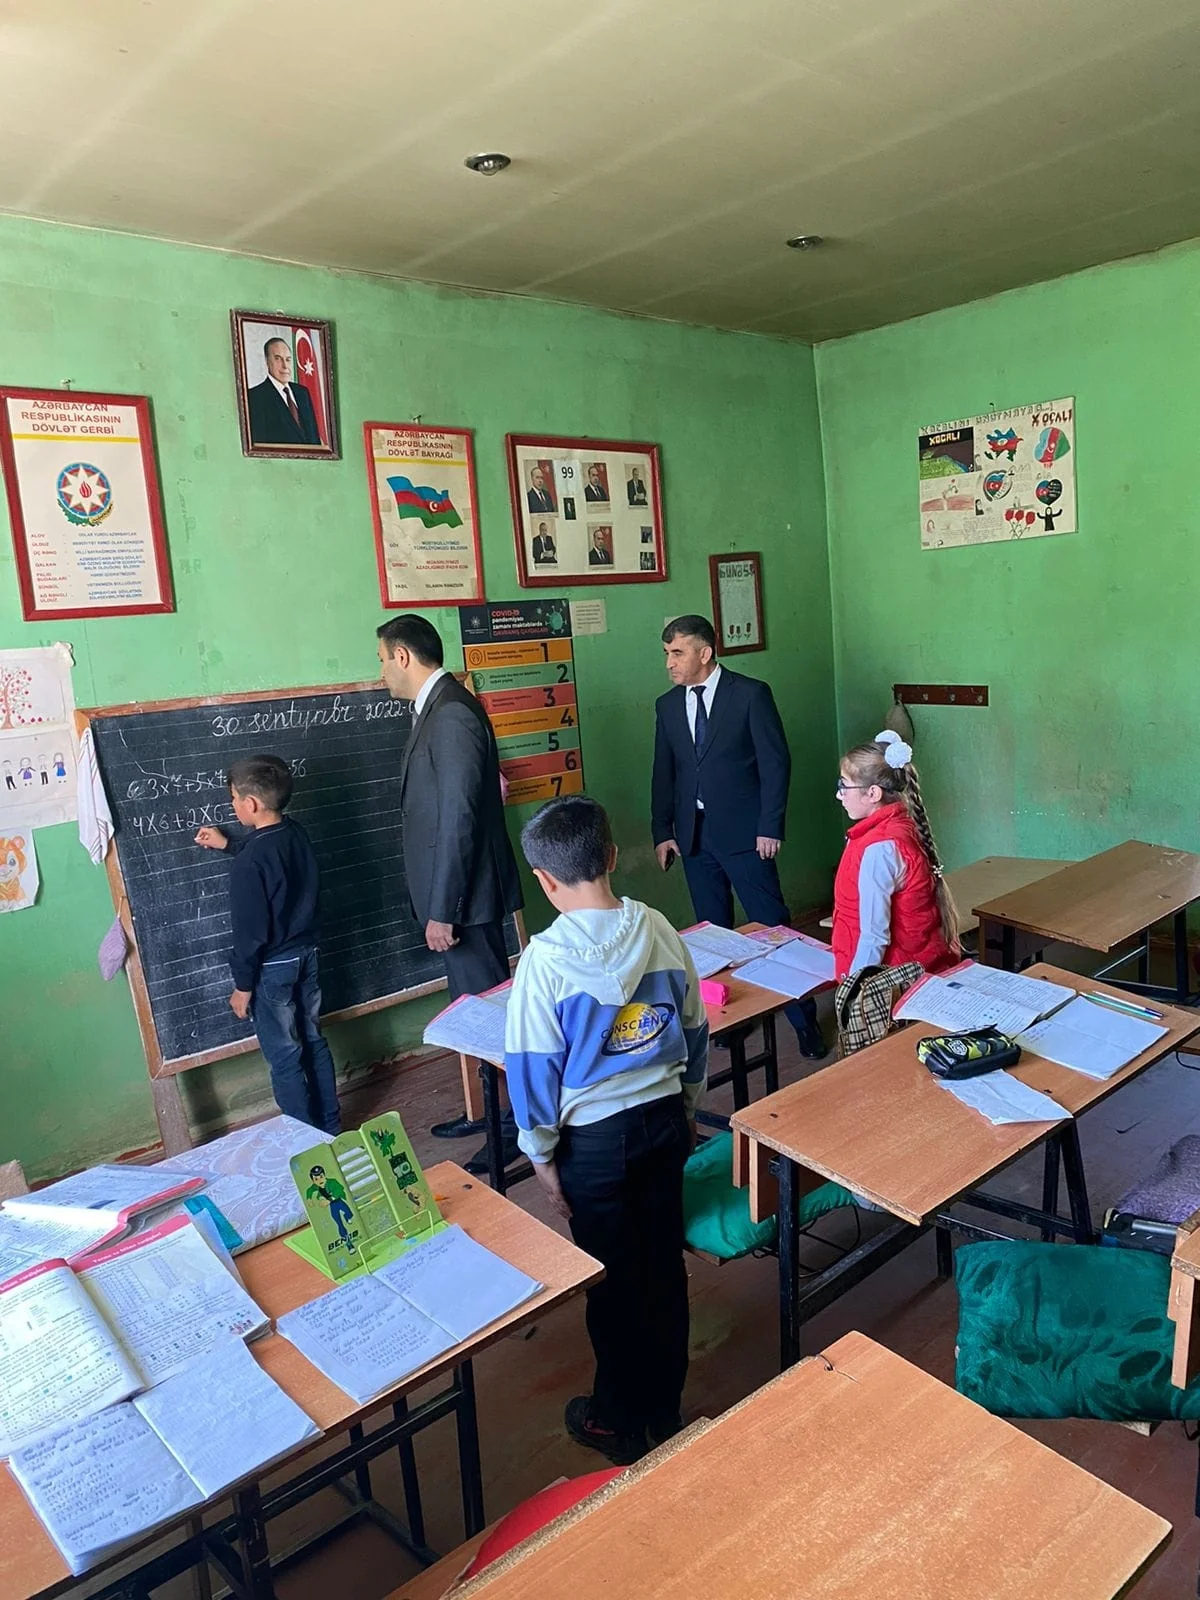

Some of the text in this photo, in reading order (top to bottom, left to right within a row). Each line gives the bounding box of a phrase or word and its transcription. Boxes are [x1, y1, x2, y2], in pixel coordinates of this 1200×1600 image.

[32, 401, 109, 412] AZƏRBAYCAN
[21, 411, 121, 424] RESPUBLİKASININ
[32, 423, 115, 434] DÖVLƏT GERBİ
[394, 431, 445, 440] AZƏRBAYCAN
[421, 450, 453, 458] BAYRAĞI
[561, 466, 574, 479] 99
[540, 643, 549, 662] 1
[557, 663, 569, 683] 2
[543, 687, 555, 707] 3
[560, 708, 574, 726] 4
[212, 716, 239, 737] 30
[548, 731, 559, 751] 5
[565, 751, 576, 770] 6
[550, 776, 562, 797] 7
